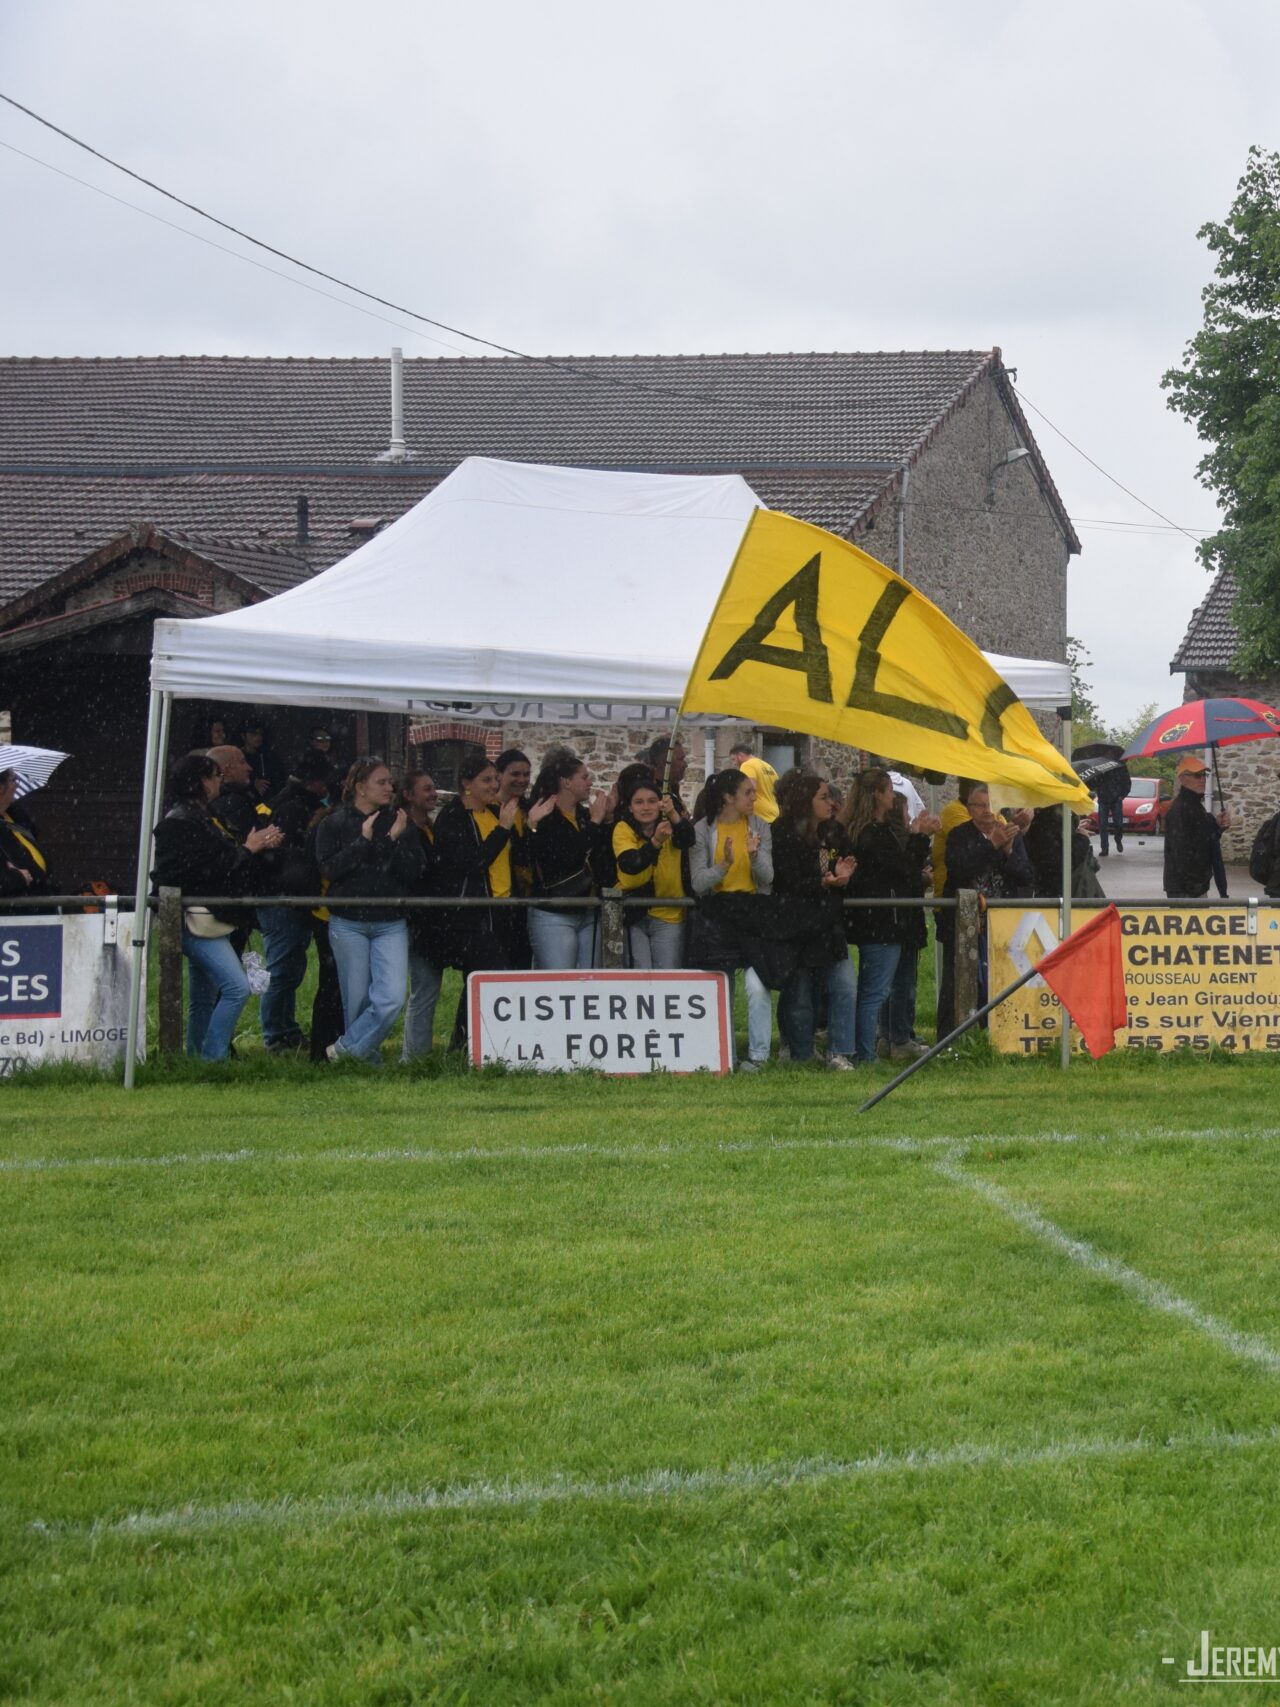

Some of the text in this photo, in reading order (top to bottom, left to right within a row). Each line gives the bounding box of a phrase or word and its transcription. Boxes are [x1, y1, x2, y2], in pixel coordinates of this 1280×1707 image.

[1121, 914, 1247, 936] GARAGE
[1125, 972, 1257, 985] ROUSSEAU AGENT
[493, 994, 707, 1022] CISTERNES
[1145, 992, 1188, 1006] Jean
[1024, 1013, 1056, 1030] Le
[1159, 1013, 1204, 1029] sur
[16, 1030, 44, 1047] Bd)
[61, 1027, 129, 1043] LIMOGE
[517, 1029, 685, 1061] LA FORÊT
[1127, 1035, 1163, 1051] 55
[1174, 1034, 1210, 1050] 35
[1219, 1034, 1251, 1050] 41
